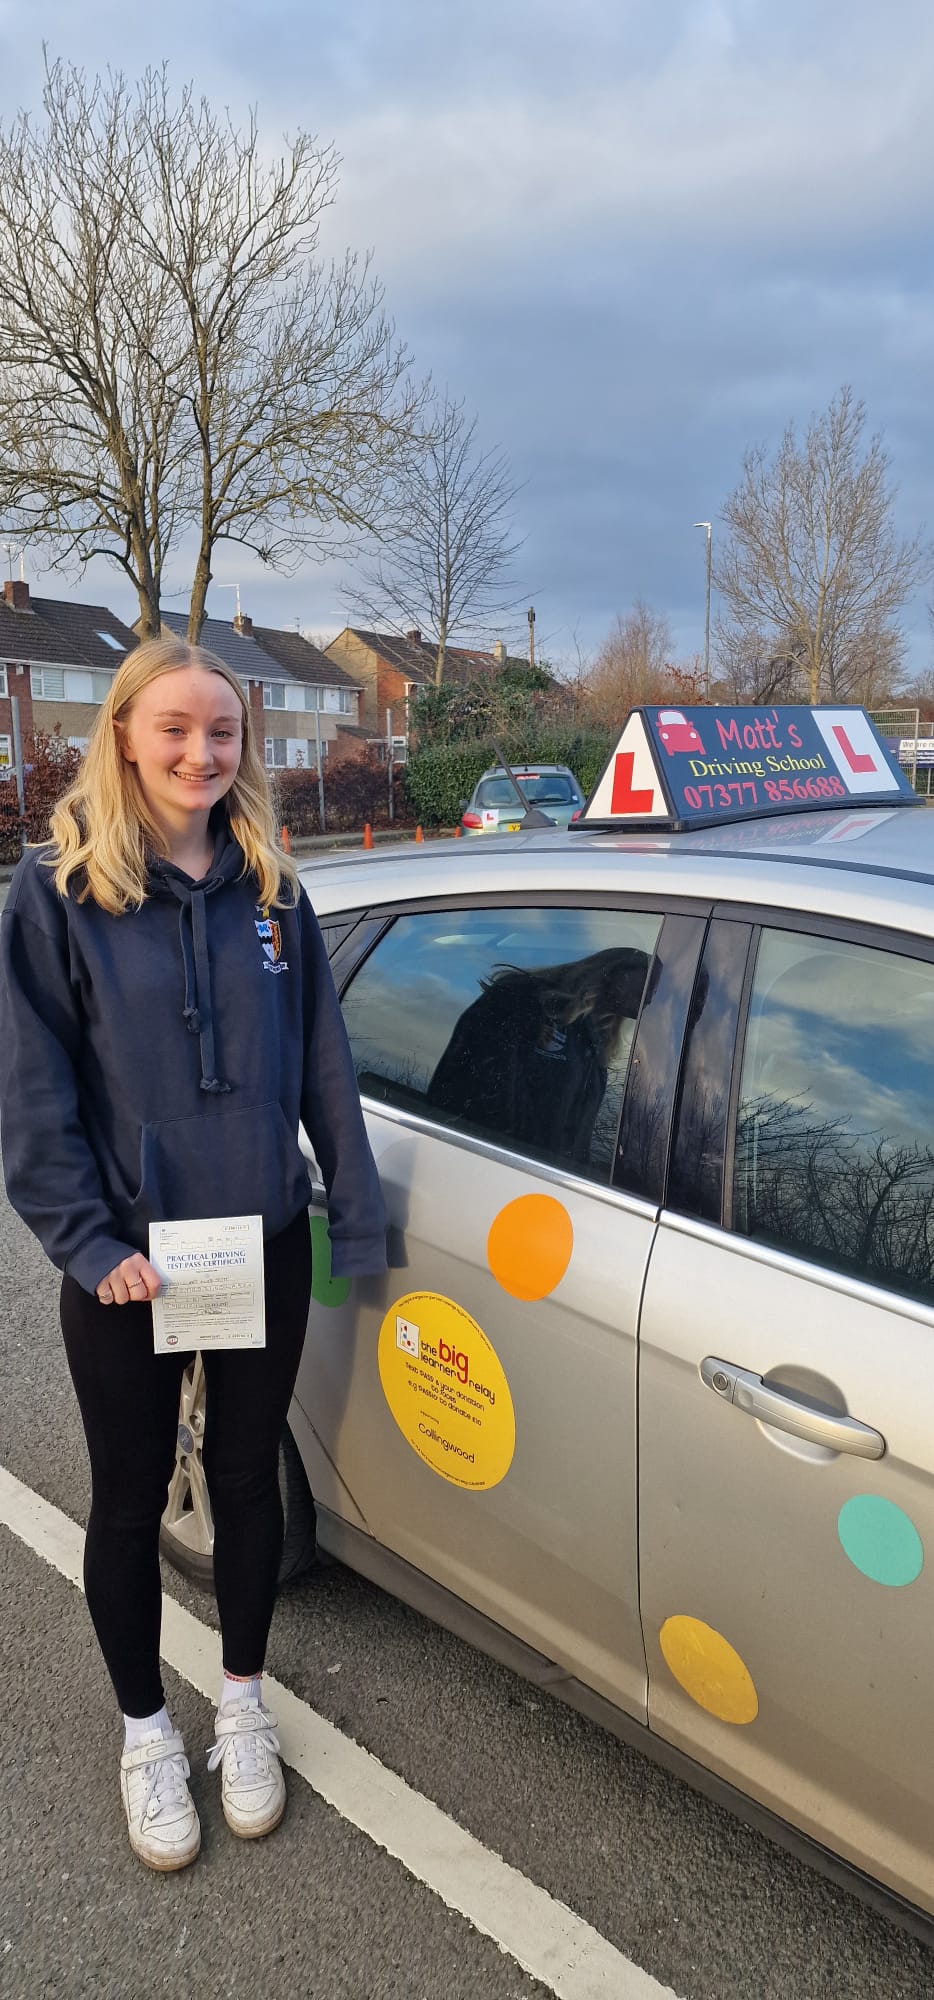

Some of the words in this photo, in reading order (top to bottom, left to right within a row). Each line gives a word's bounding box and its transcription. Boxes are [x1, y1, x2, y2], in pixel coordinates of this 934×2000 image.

[715, 710, 803, 751] Matt's
[831, 725, 878, 773] L
[610, 752, 655, 814] L
[688, 757, 766, 778] Driving
[766, 753, 827, 774] School
[683, 781, 758, 809] 07377
[764, 776, 846, 802] 856688
[166, 1252, 209, 1263] PRACTICAL
[211, 1250, 246, 1259] DRIVING
[167, 1262, 183, 1270] TEST
[184, 1261, 201, 1269] PASS
[203, 1258, 246, 1268] CERTIFICATE
[420, 1340, 437, 1357] the
[438, 1338, 469, 1384] big
[420, 1352, 457, 1378] learner
[469, 1379, 496, 1405] relay
[418, 1422, 475, 1463] Collingwood
